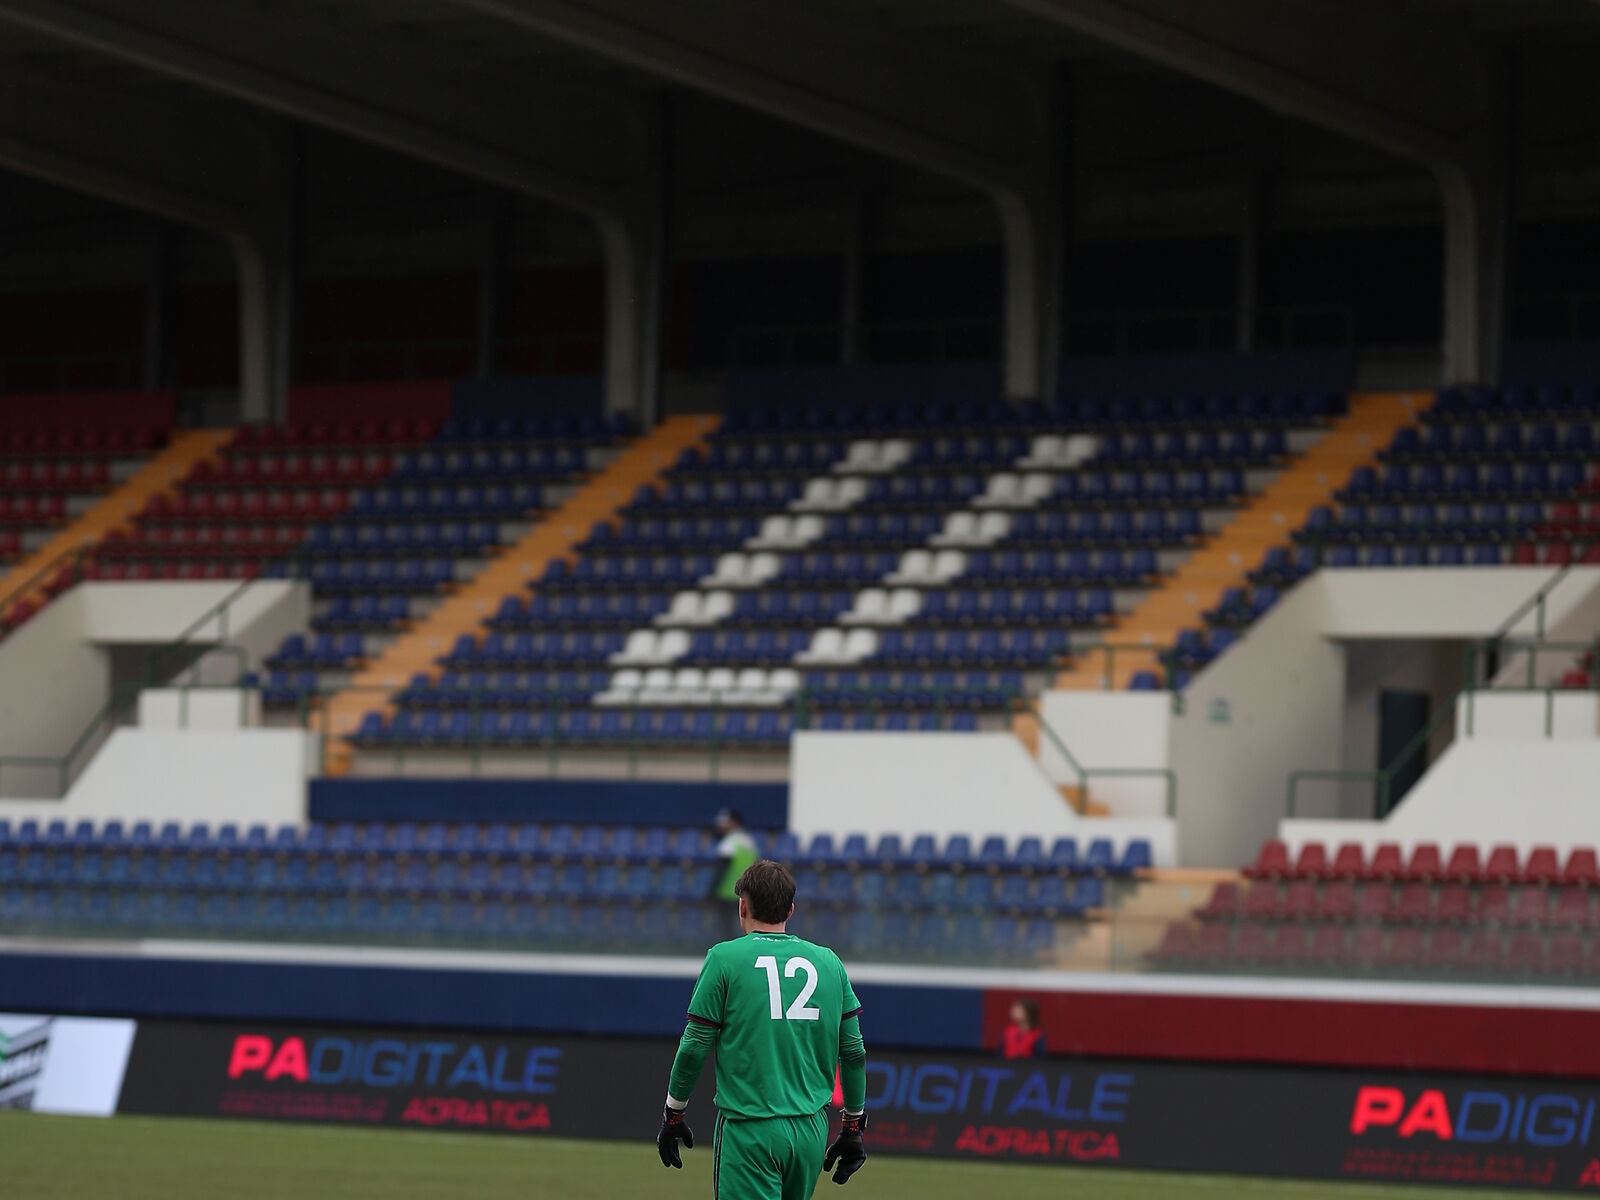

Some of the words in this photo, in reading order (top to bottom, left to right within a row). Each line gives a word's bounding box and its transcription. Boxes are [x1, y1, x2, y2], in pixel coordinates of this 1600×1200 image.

[754, 955, 820, 1021] 12
[403, 1098, 550, 1128] ADRIATICA
[833, 1063, 1131, 1120] DIGITALE
[956, 1125, 1120, 1158] ADRIATICA
